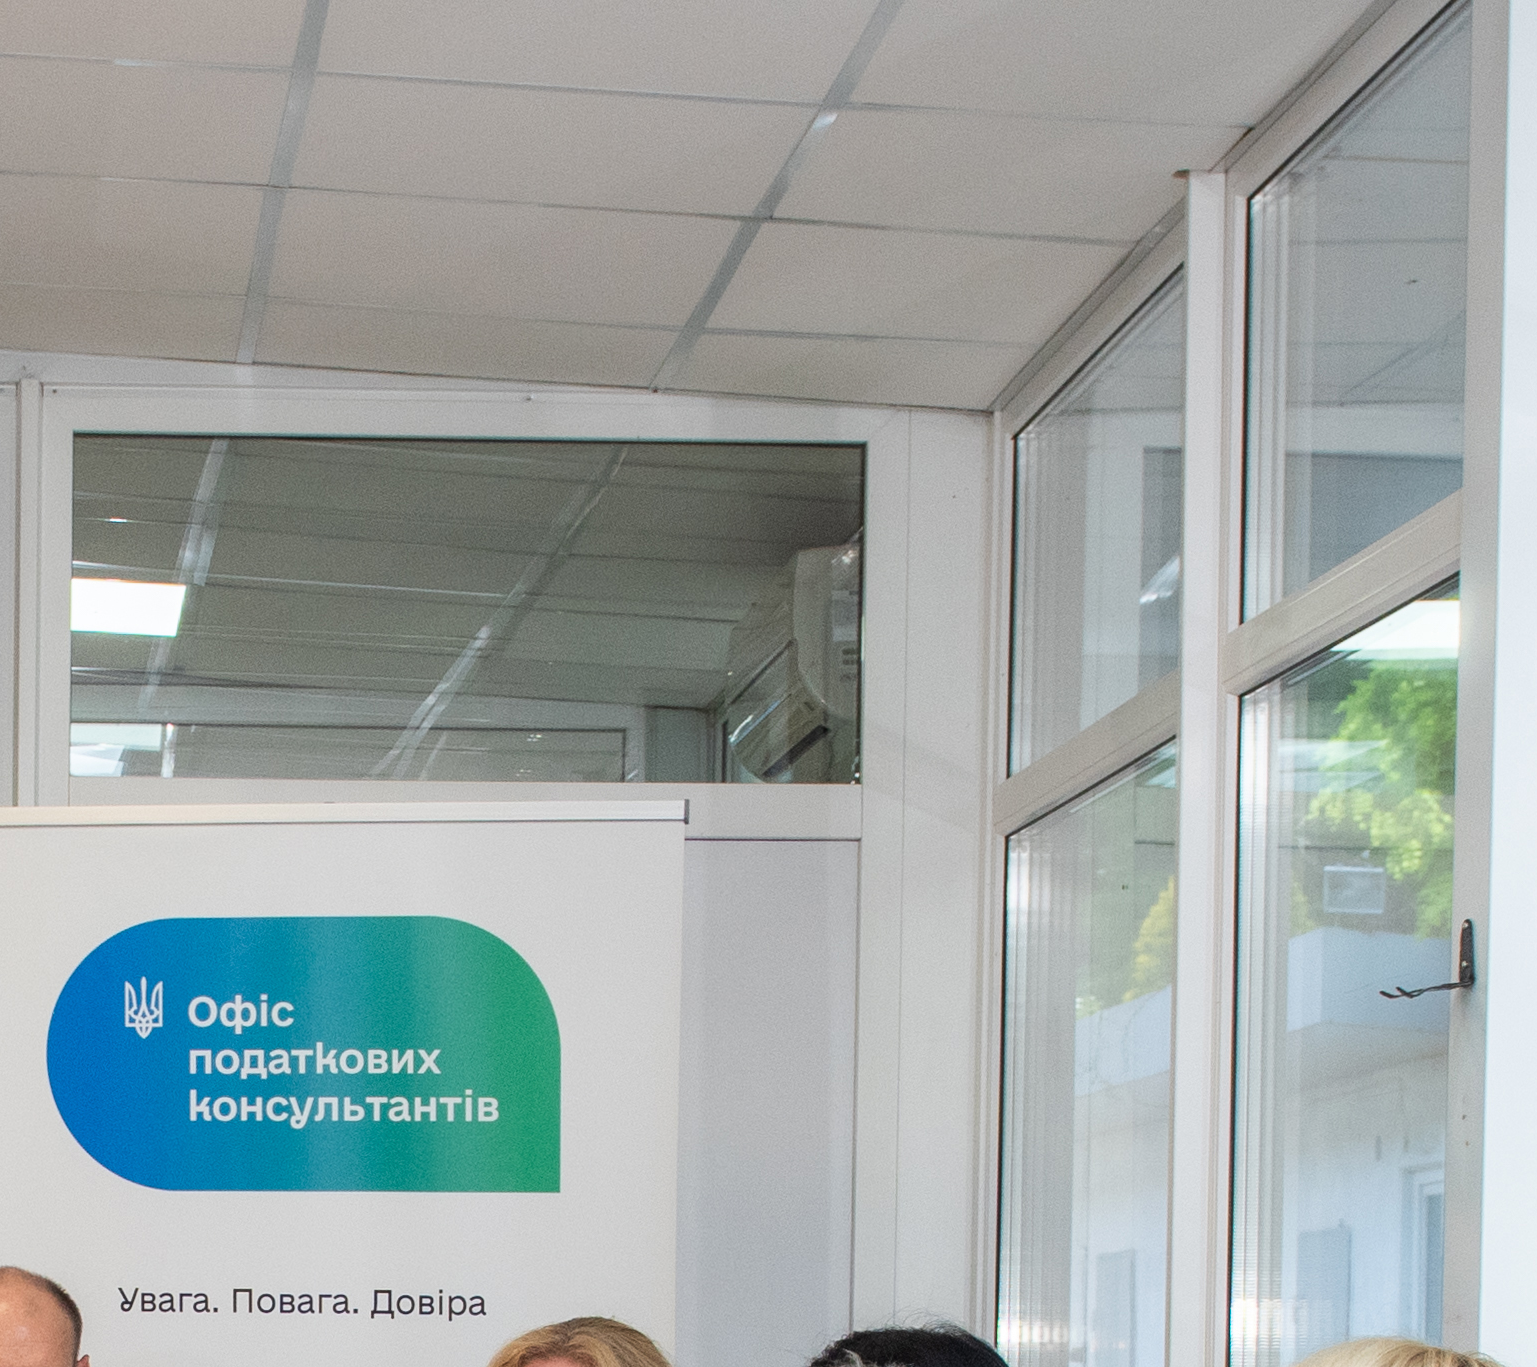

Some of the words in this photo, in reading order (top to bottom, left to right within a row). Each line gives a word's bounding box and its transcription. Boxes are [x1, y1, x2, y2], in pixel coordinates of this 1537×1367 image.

[188, 993, 295, 1035] Офіс
[189, 1042, 442, 1080] податкових
[189, 1089, 500, 1130] консультантів
[118, 1286, 220, 1313] Увага.
[232, 1288, 360, 1315] Повага.
[370, 1289, 488, 1322] Довіра
